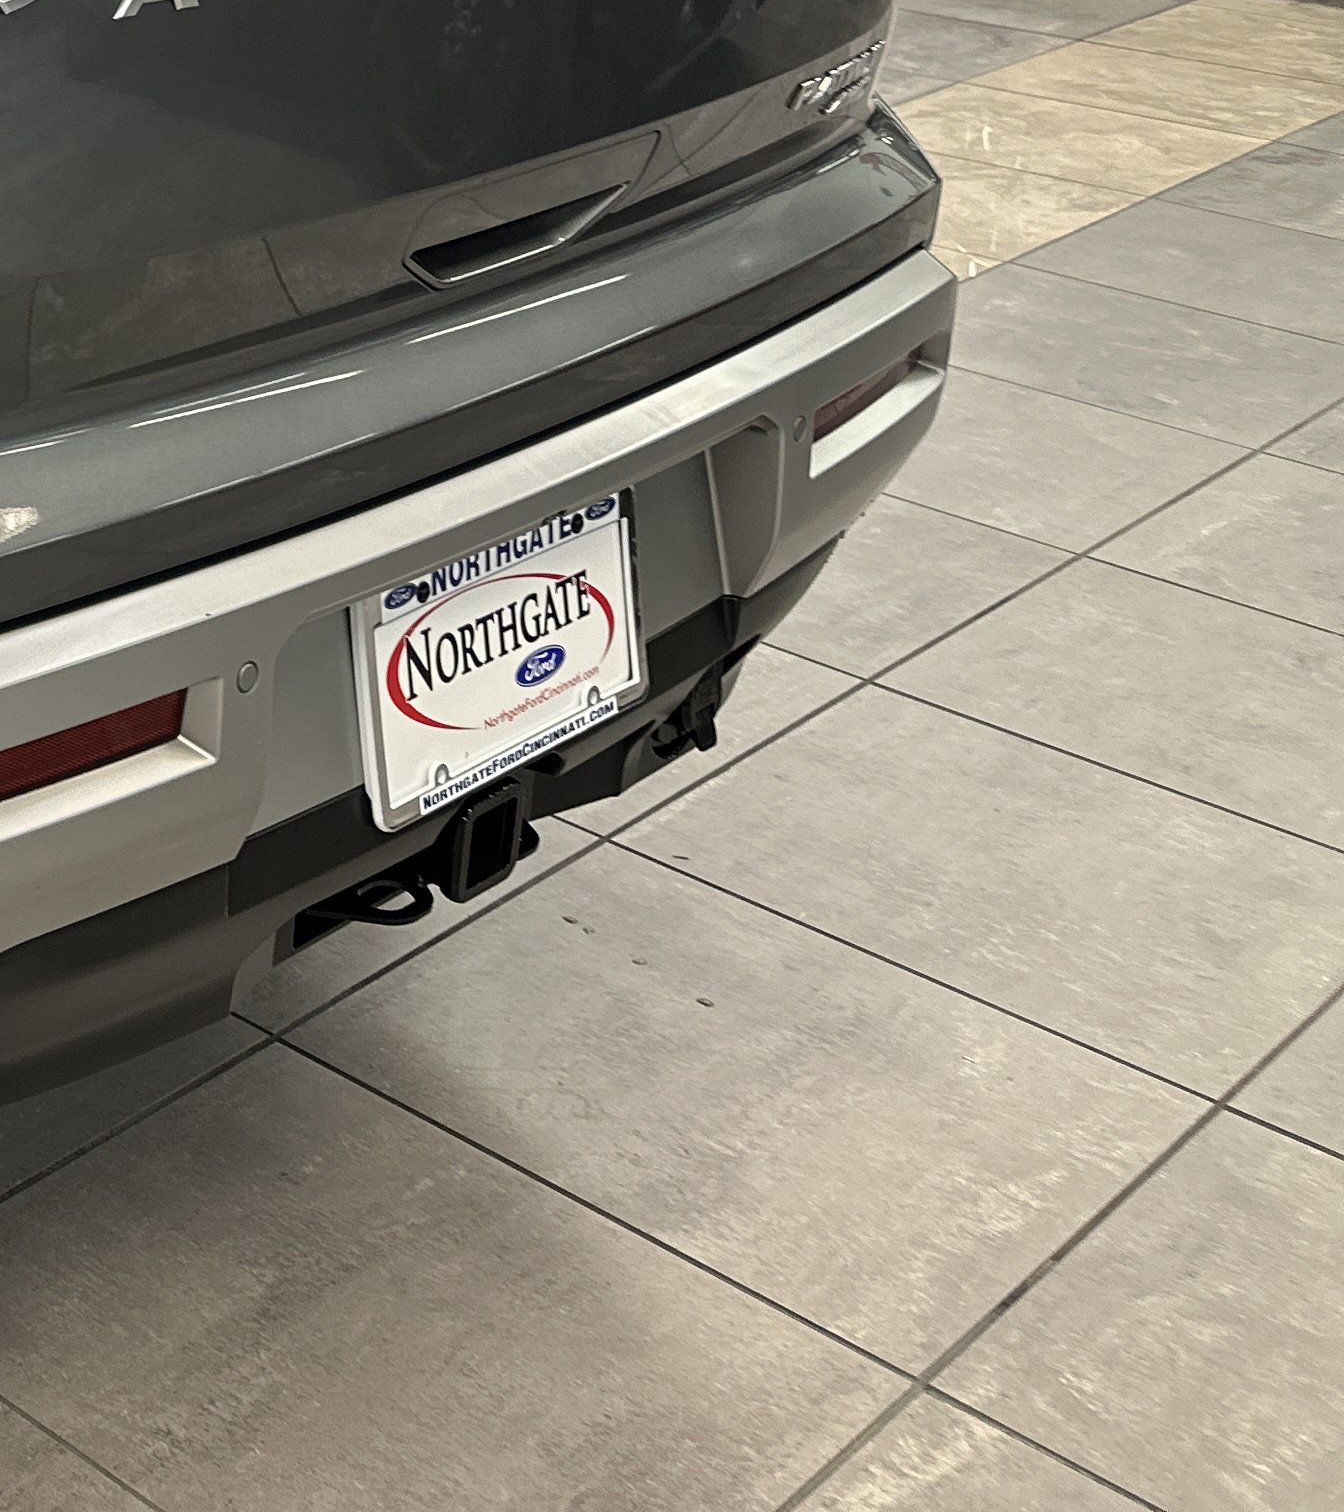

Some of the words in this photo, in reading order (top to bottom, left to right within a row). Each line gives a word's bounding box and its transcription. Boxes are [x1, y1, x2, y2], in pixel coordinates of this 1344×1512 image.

[430, 510, 574, 597] NORTHGATE
[403, 569, 592, 703] NORTHGATE
[522, 649, 558, 682] Ford
